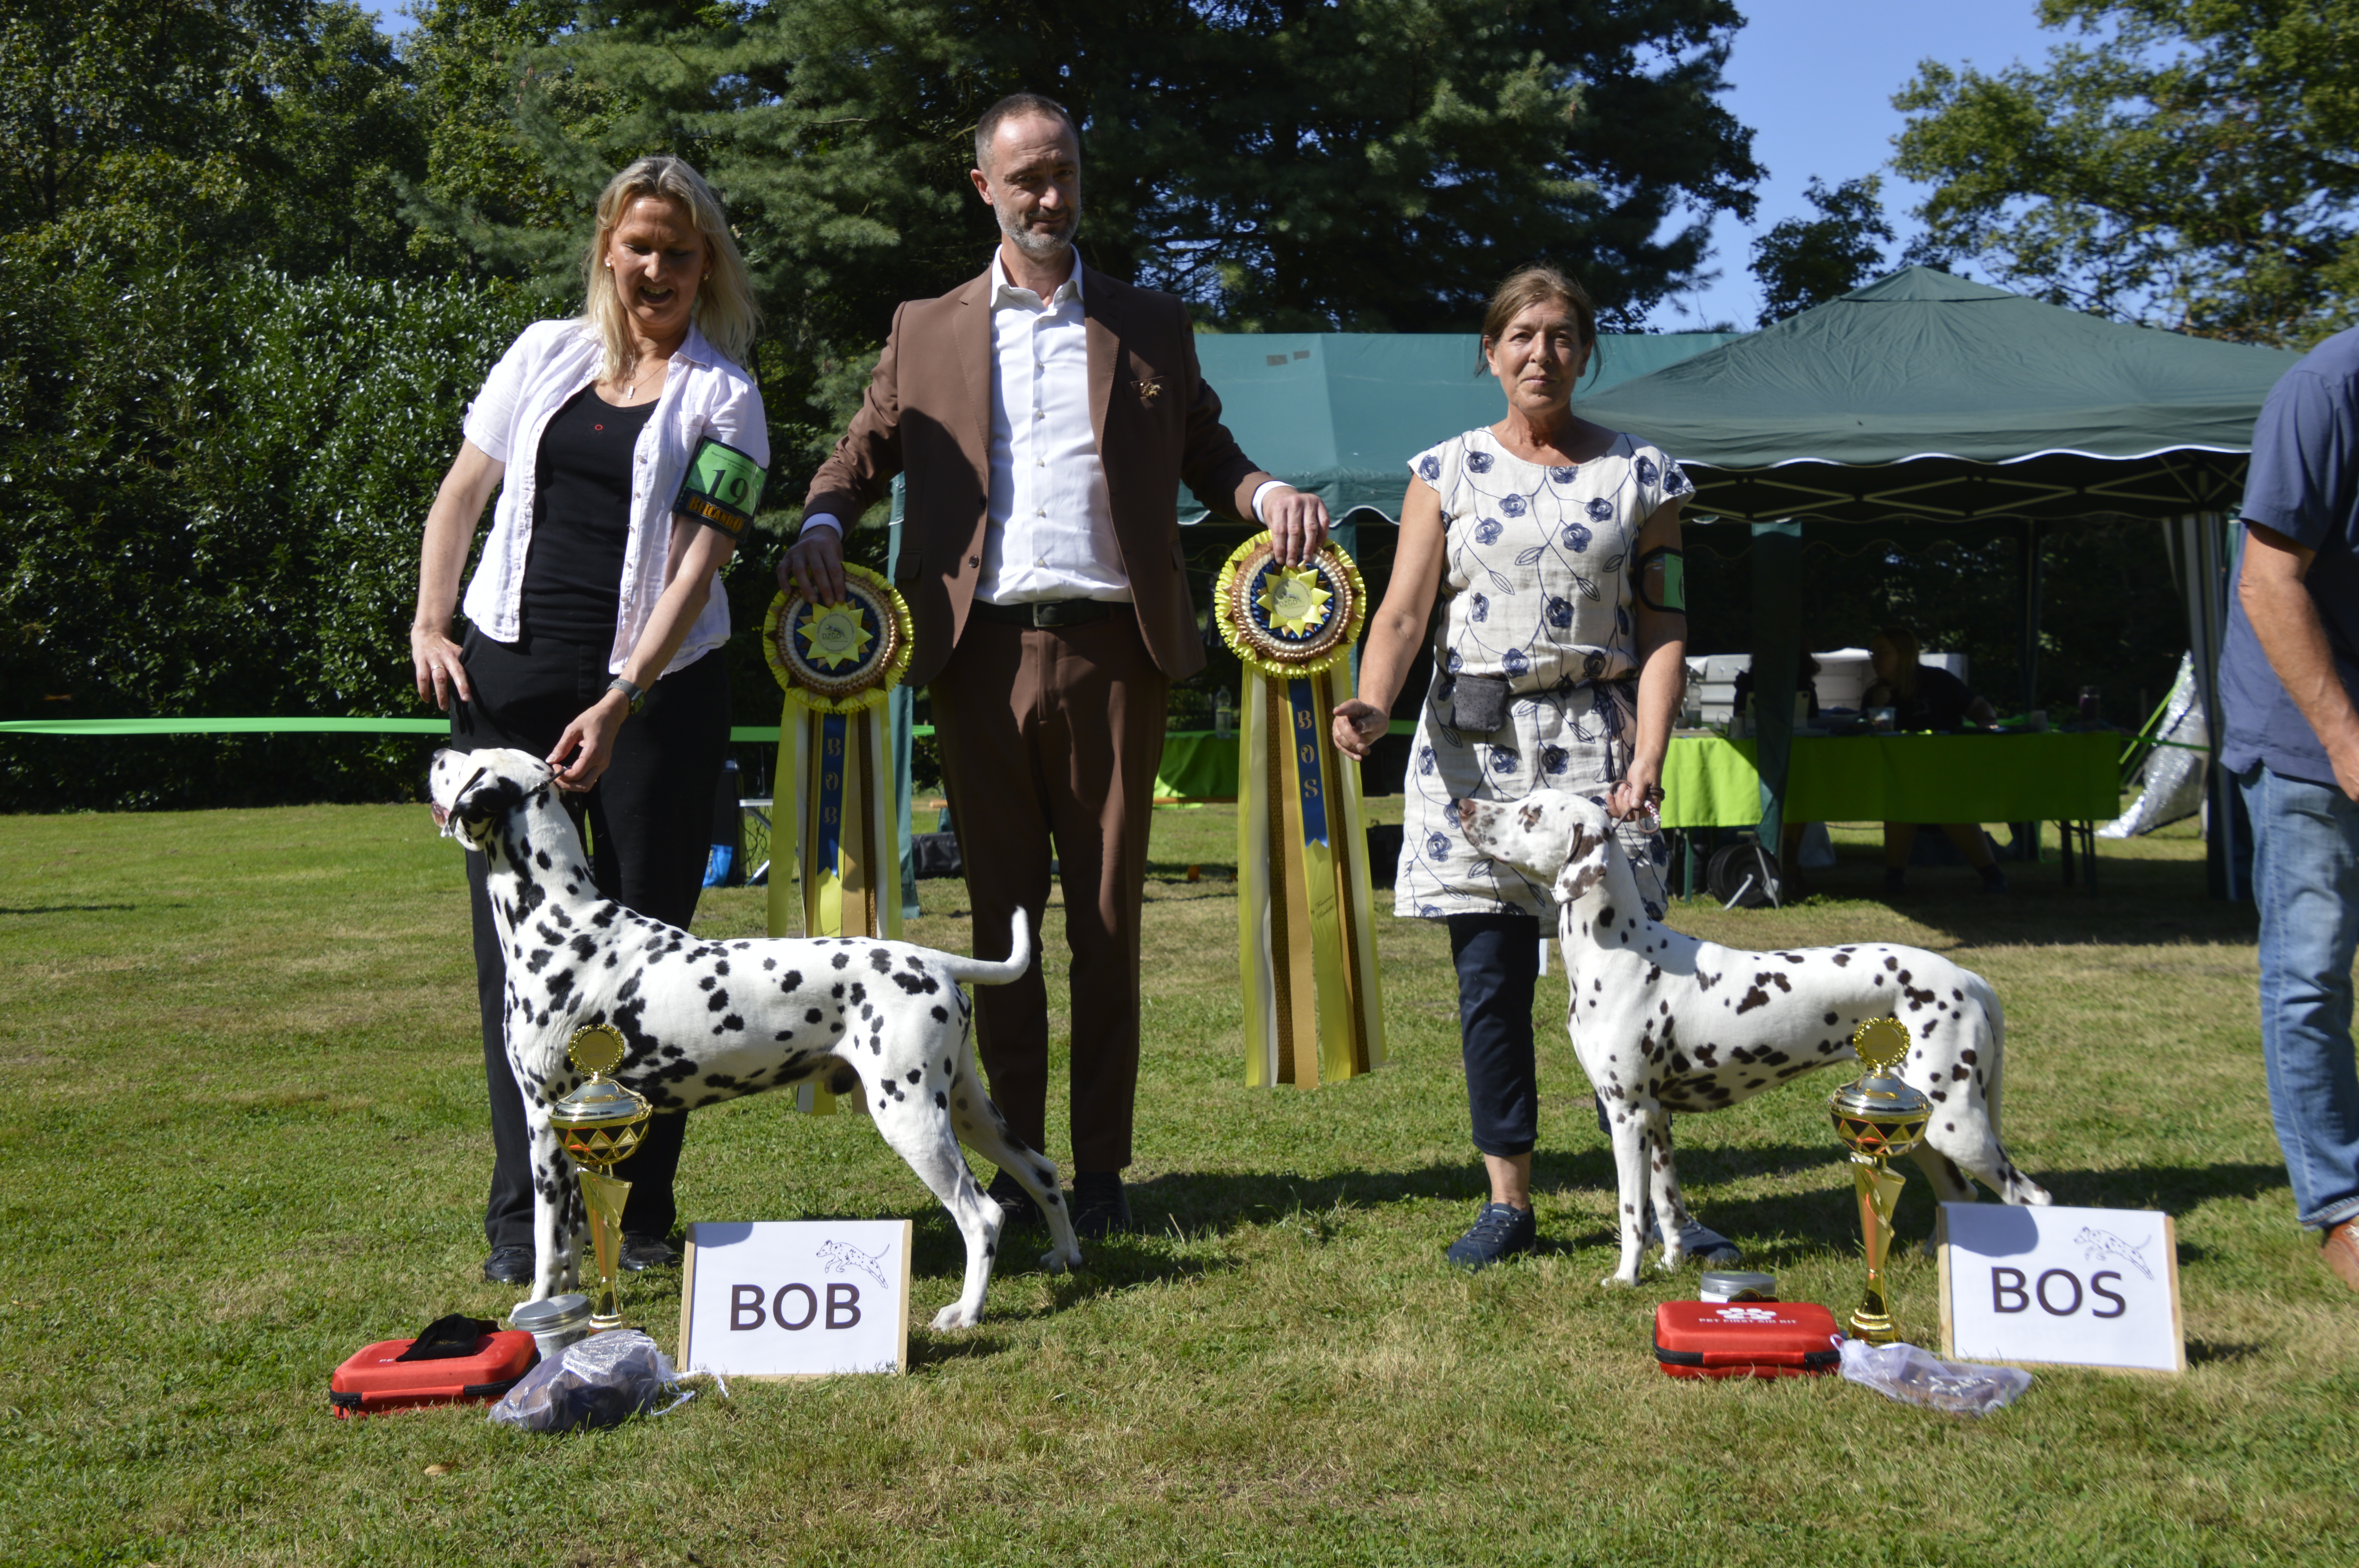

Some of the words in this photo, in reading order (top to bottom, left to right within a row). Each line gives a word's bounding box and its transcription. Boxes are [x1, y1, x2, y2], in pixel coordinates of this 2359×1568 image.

[707, 470, 748, 506] 19
[687, 495, 743, 532] BELCANDO
[1298, 710, 1318, 798] BOS
[823, 738, 841, 825] BOB
[730, 1282, 861, 1331] BOB
[1991, 1267, 2126, 1319] BOS
